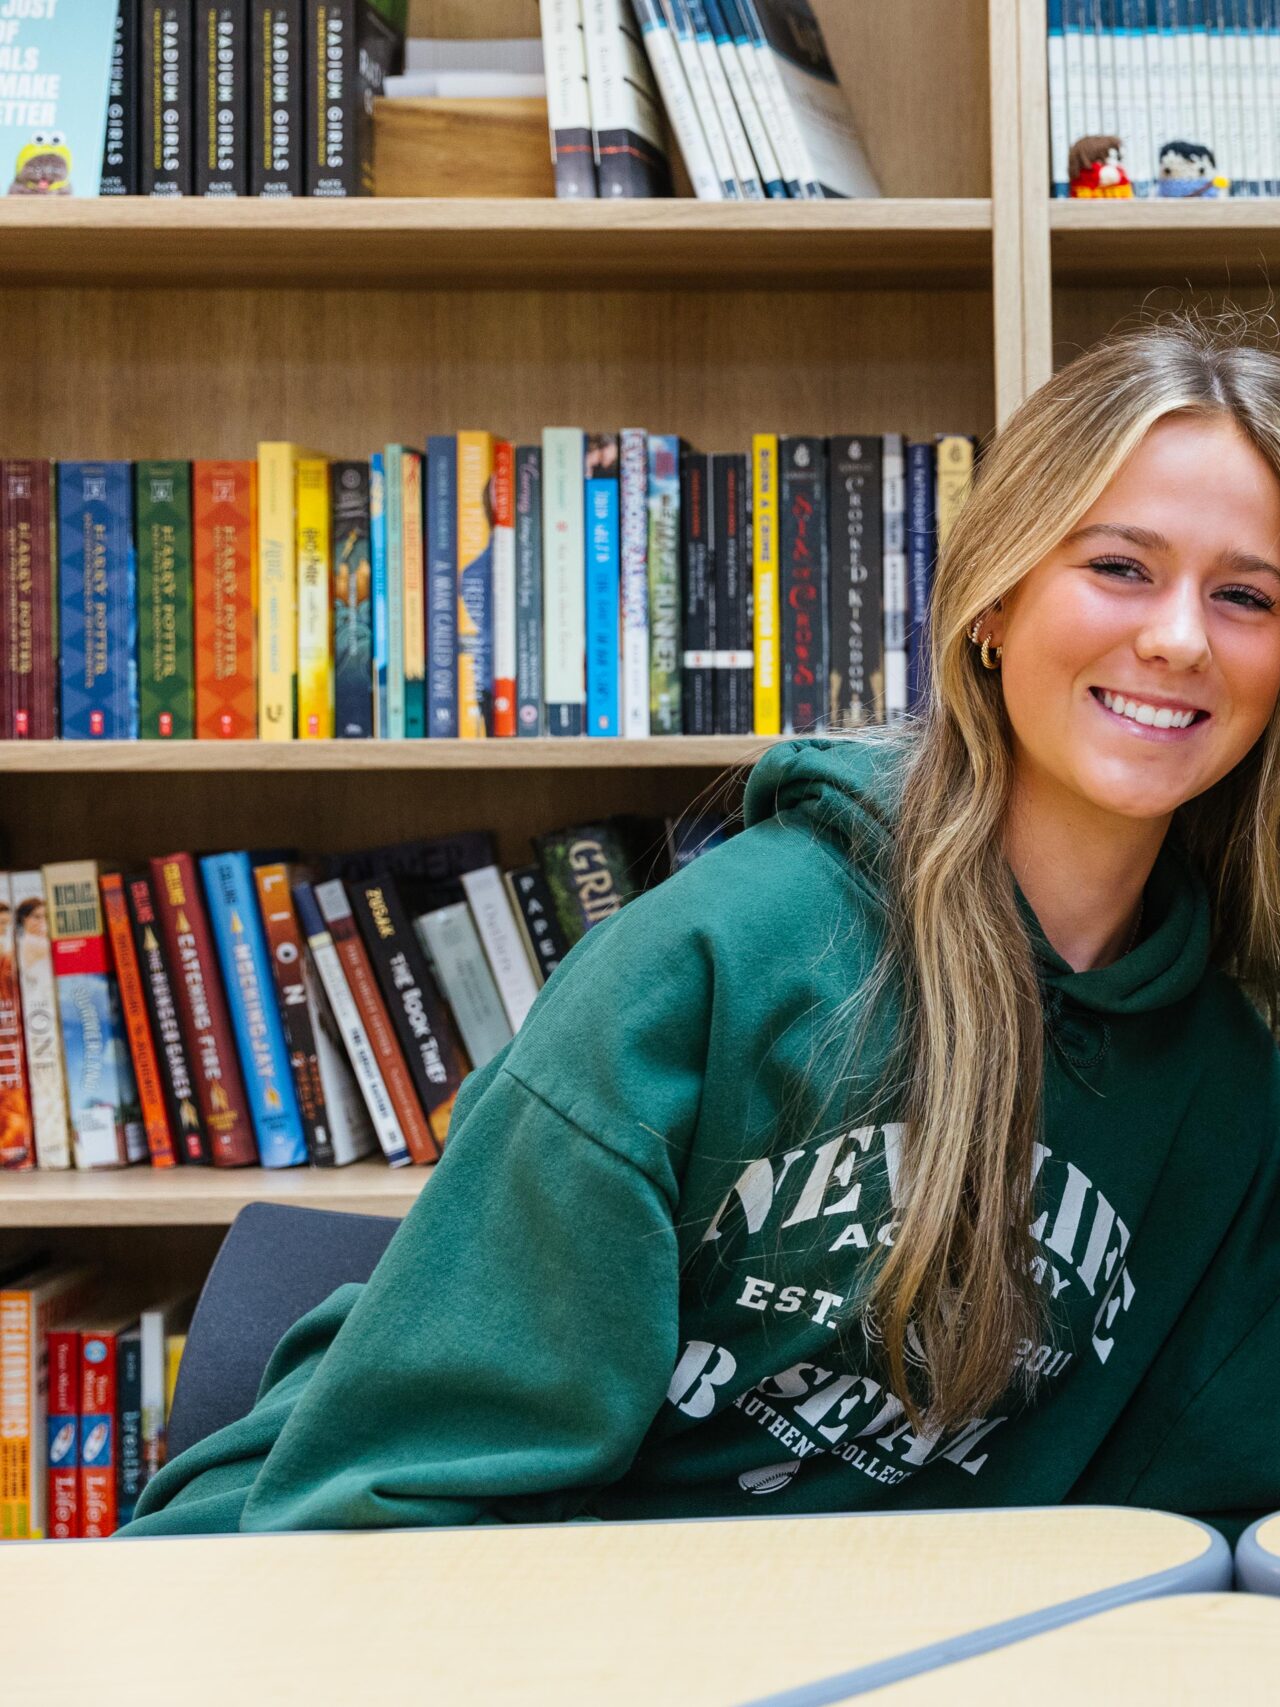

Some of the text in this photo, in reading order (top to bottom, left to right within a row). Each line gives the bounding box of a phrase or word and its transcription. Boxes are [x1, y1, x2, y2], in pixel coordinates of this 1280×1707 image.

[0, 46, 39, 72] ALS
[2, 0, 56, 18] JUST
[164, 22, 178, 170] RADIUM GIRLS
[218, 22, 234, 170] RADIUM GIRLS
[273, 23, 288, 170] RADIUM GIRLS
[328, 20, 343, 167] RADIUM GIRLS
[760, 449, 770, 562] BORN A CRIME
[845, 477, 868, 583] CROOKED
[17, 522, 32, 674] HARRY POTTER
[94, 524, 107, 675] HARRY POTTER
[162, 525, 176, 678] HARRY POTTER
[223, 526, 236, 677] HARRY POTTER
[433, 576, 452, 610] MAN
[434, 560, 451, 571] A
[759, 572, 772, 635] TREVOR
[433, 613, 453, 666] CALLED
[654, 583, 675, 673] RUNNER
[262, 874, 306, 1006] LION
[365, 887, 395, 939] ZUSAK
[25, 1008, 56, 1069] ONE
[151, 972, 180, 1042] HUNGER
[177, 933, 222, 1080] CATCHING FIRE
[235, 943, 276, 1078] MOCKINGJAY
[390, 951, 448, 1085] THE BOOK THIEF
[165, 1043, 191, 1099] GAMES
[735, 1275, 844, 1330] EST.
[828, 1223, 1072, 1299] ACMY
[0, 1299, 28, 1438] FREAKONOMICS
[732, 1385, 912, 1485] AUTHEN COLLEC
[55, 1476, 76, 1520] Life
[86, 1476, 107, 1521] Life
